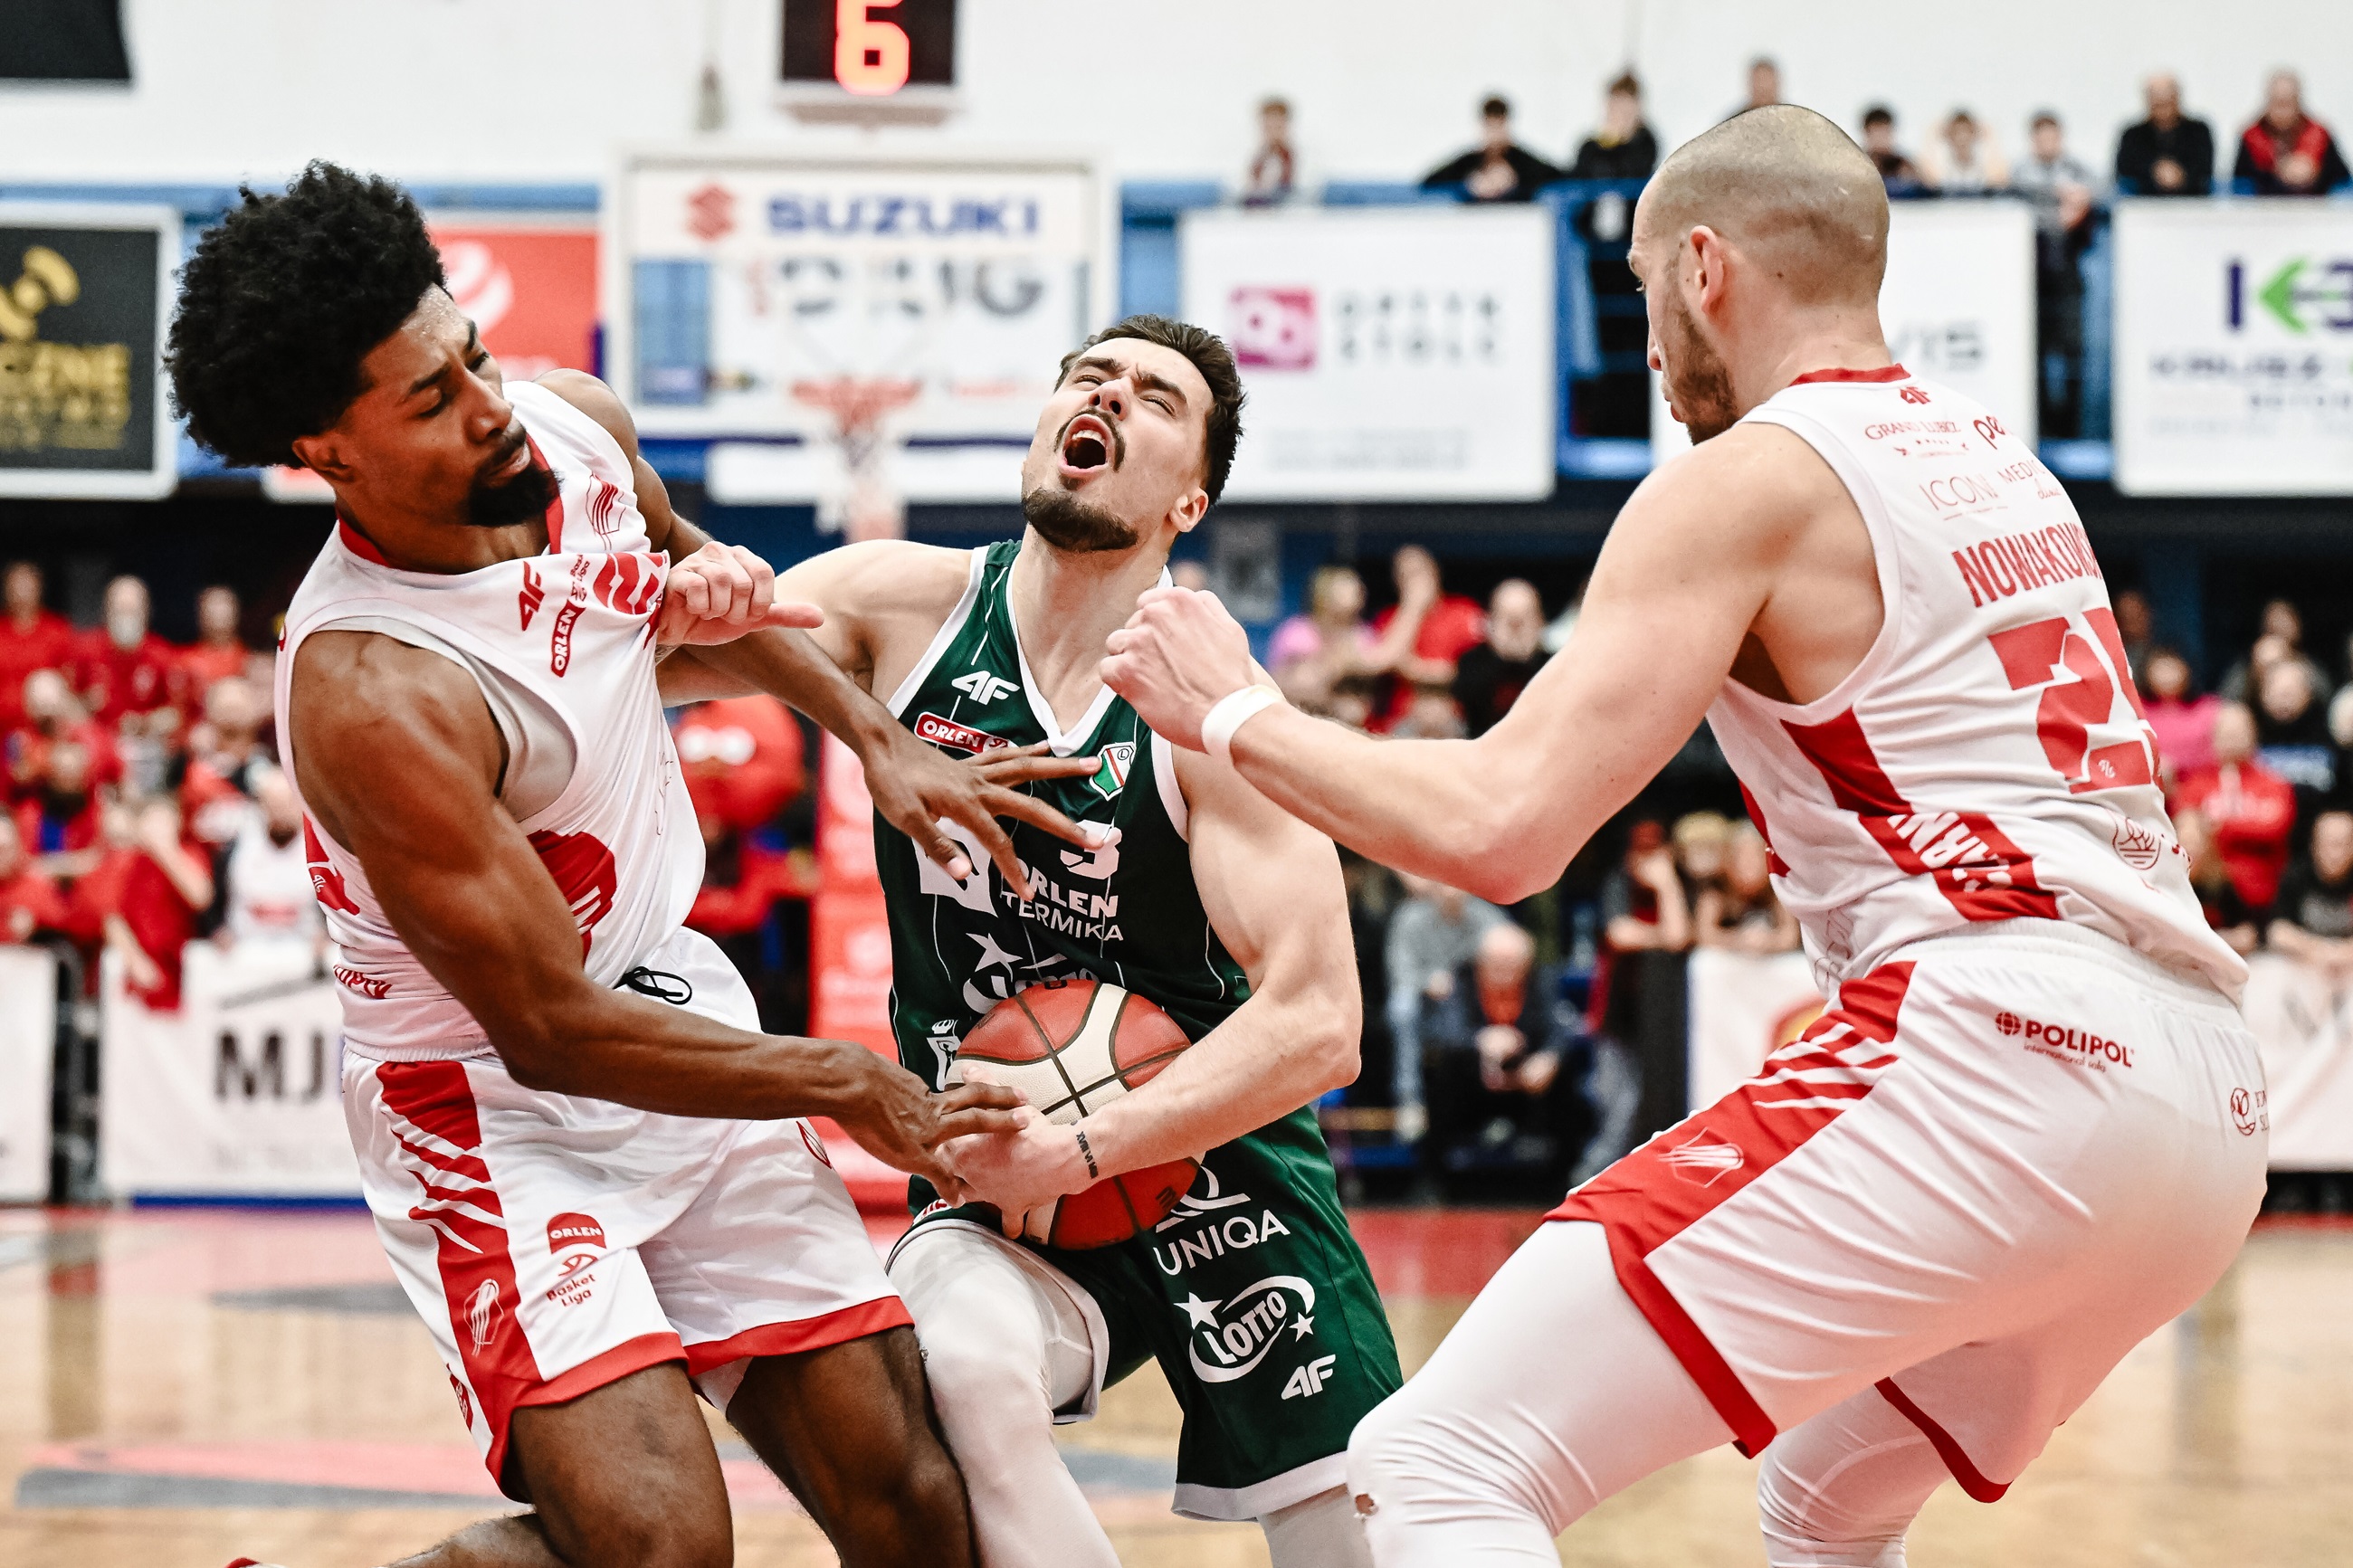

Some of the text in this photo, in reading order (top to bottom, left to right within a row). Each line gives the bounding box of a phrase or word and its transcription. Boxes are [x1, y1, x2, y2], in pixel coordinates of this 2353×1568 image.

[834, 0, 910, 95] 6
[767, 194, 1039, 233] SUZUKI
[1900, 386, 1930, 404] 4F
[519, 561, 545, 632] 4F
[555, 609, 576, 670] ORLEN
[951, 670, 1020, 705] 4F
[922, 720, 979, 747] ORLEN
[1001, 890, 1124, 942] TERMIKA
[2025, 1019, 2132, 1068] POLIPOL
[550, 1227, 603, 1240] ORLEN
[1153, 1209, 1291, 1277] UNIQA
[546, 1273, 595, 1301] Basket
[560, 1288, 592, 1307] Liga
[1202, 1290, 1288, 1365] LOTTO
[1281, 1354, 1337, 1401] 4F
